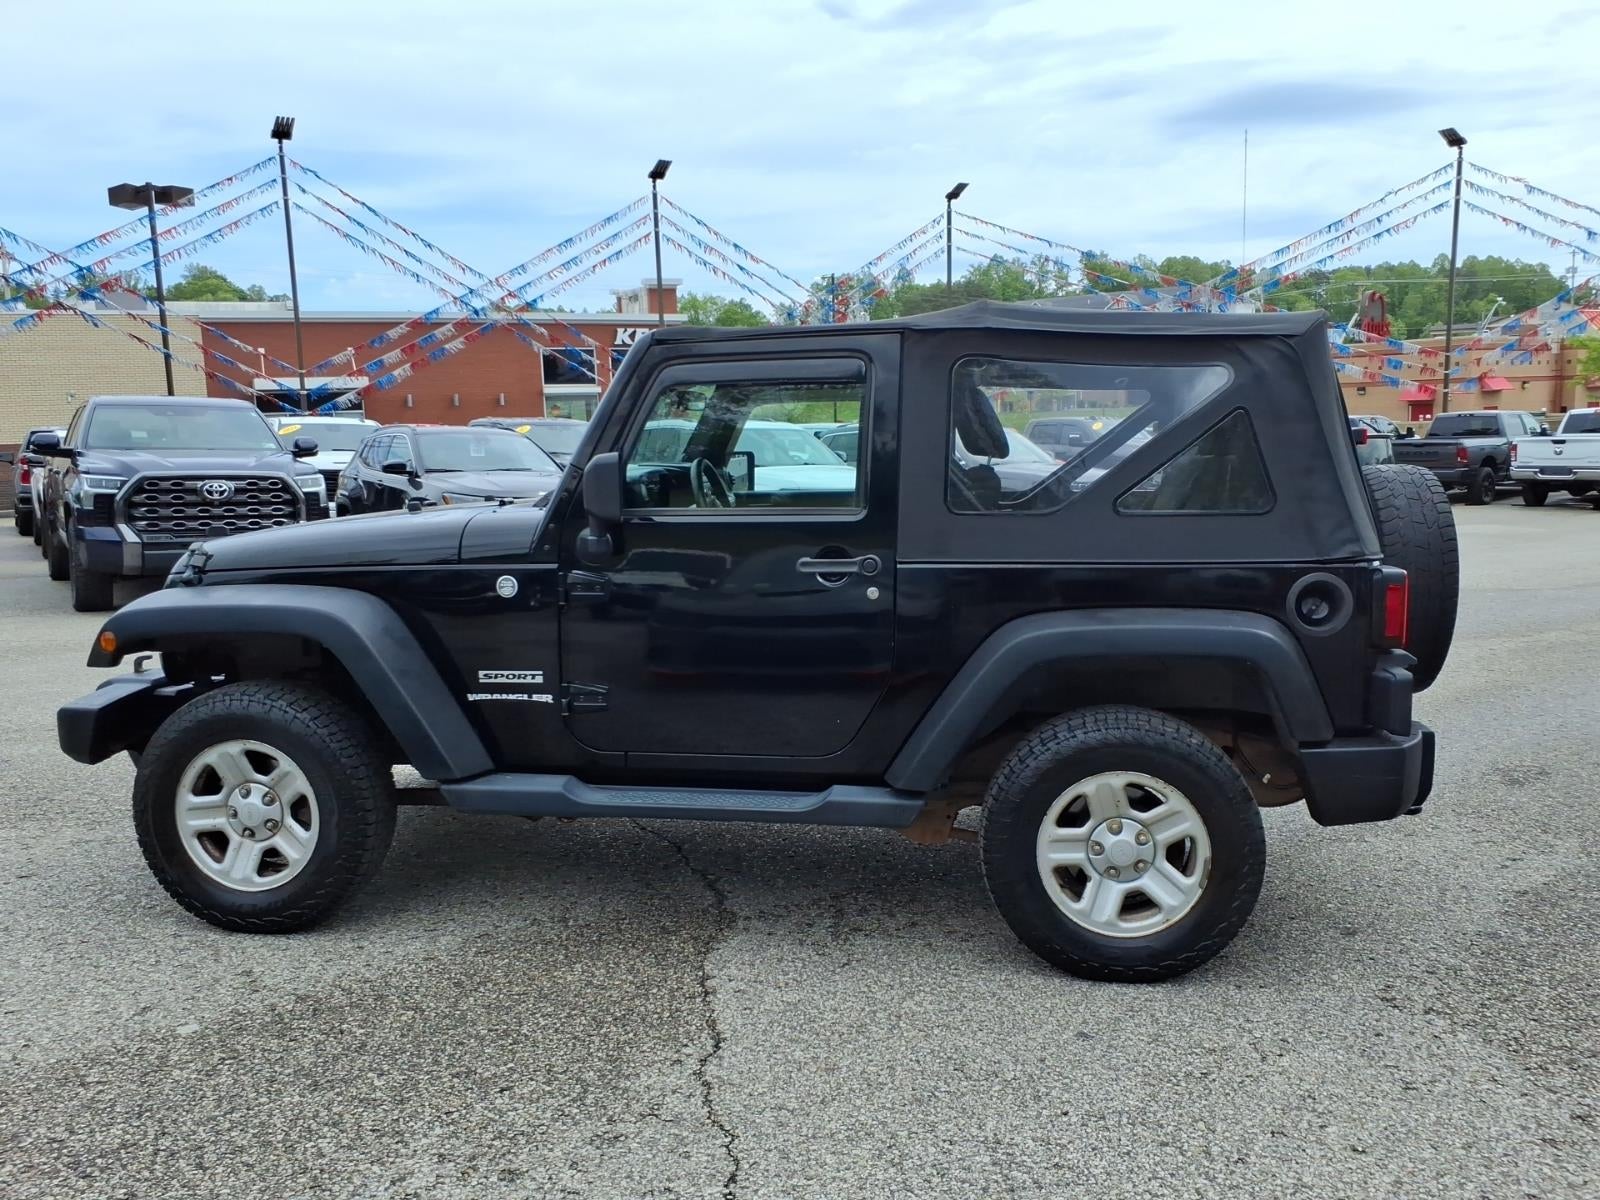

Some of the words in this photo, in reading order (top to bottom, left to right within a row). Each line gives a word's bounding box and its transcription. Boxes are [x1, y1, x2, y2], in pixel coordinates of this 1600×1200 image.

[614, 328, 656, 344] KF
[480, 672, 542, 681] SPORT
[467, 693, 554, 703] WRANGLER
